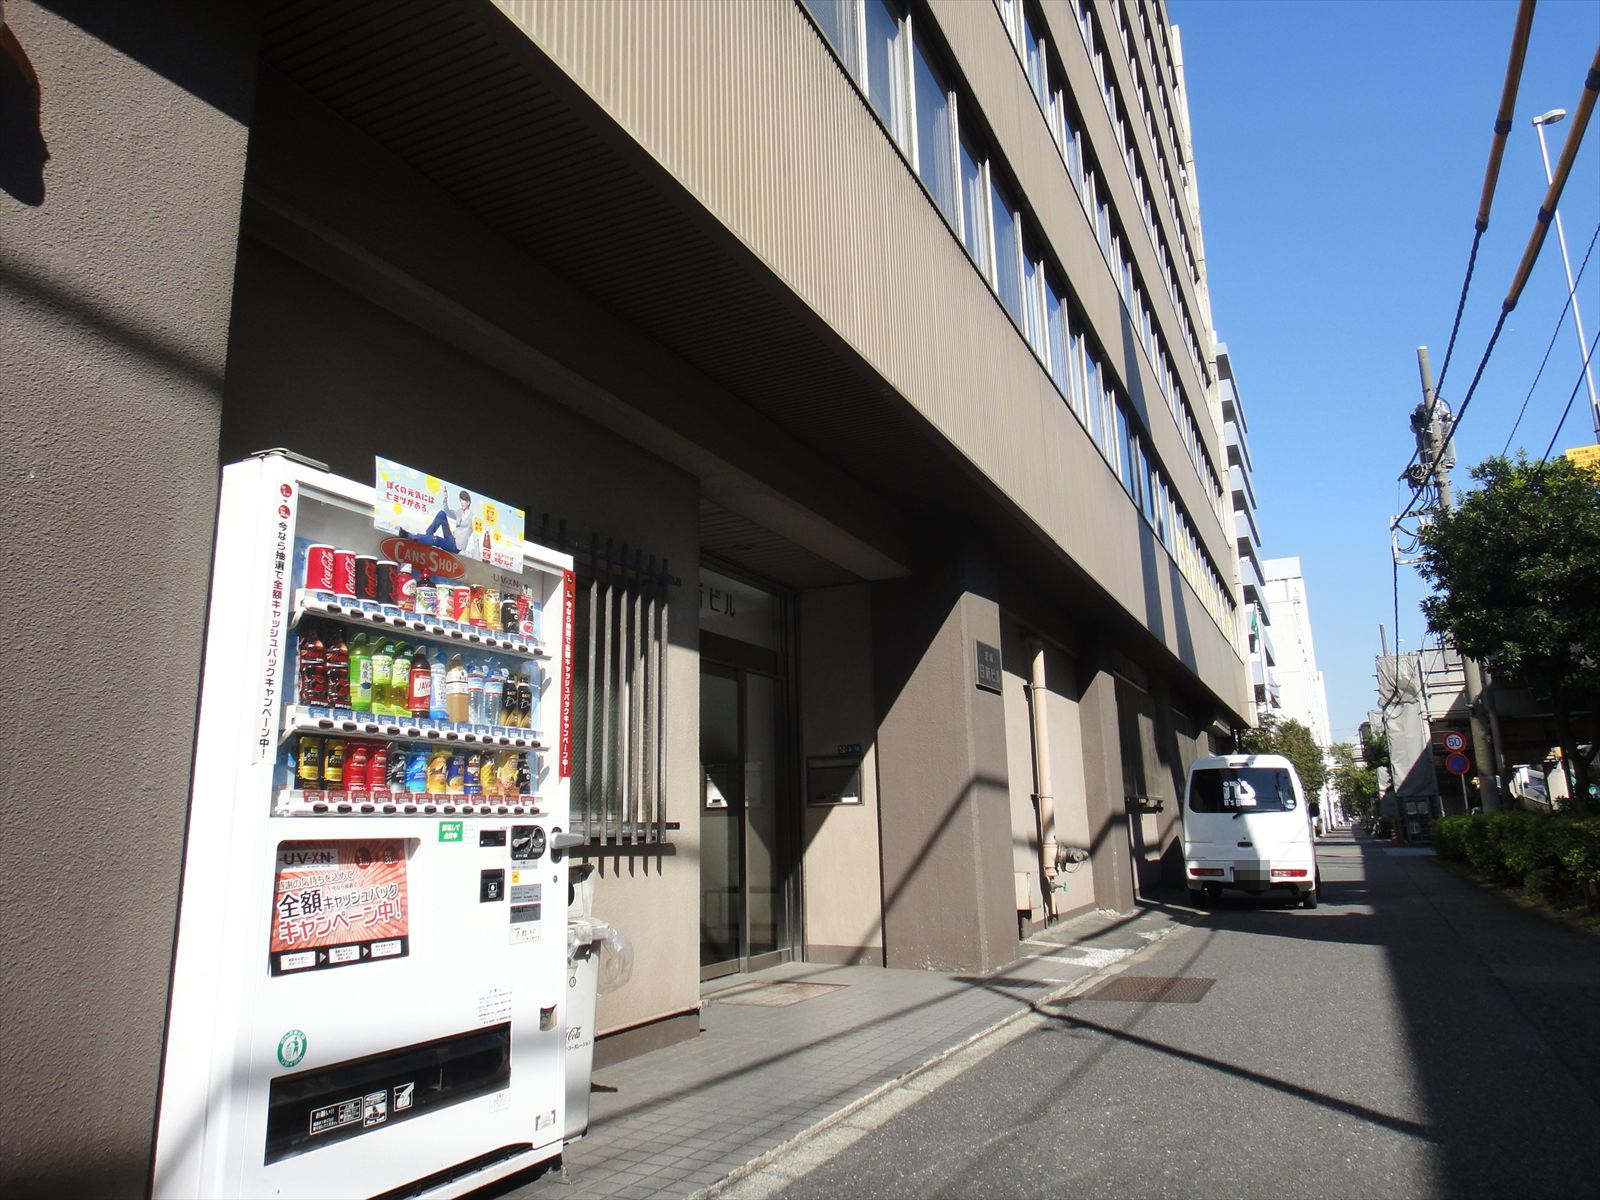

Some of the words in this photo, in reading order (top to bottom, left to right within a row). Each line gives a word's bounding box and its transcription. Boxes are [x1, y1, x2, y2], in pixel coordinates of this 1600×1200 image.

[394, 541, 426, 565] CANS
[428, 551, 459, 573] SHOP
[1448, 738, 1460, 747] 50
[280, 899, 401, 944] キャンペーン中!
